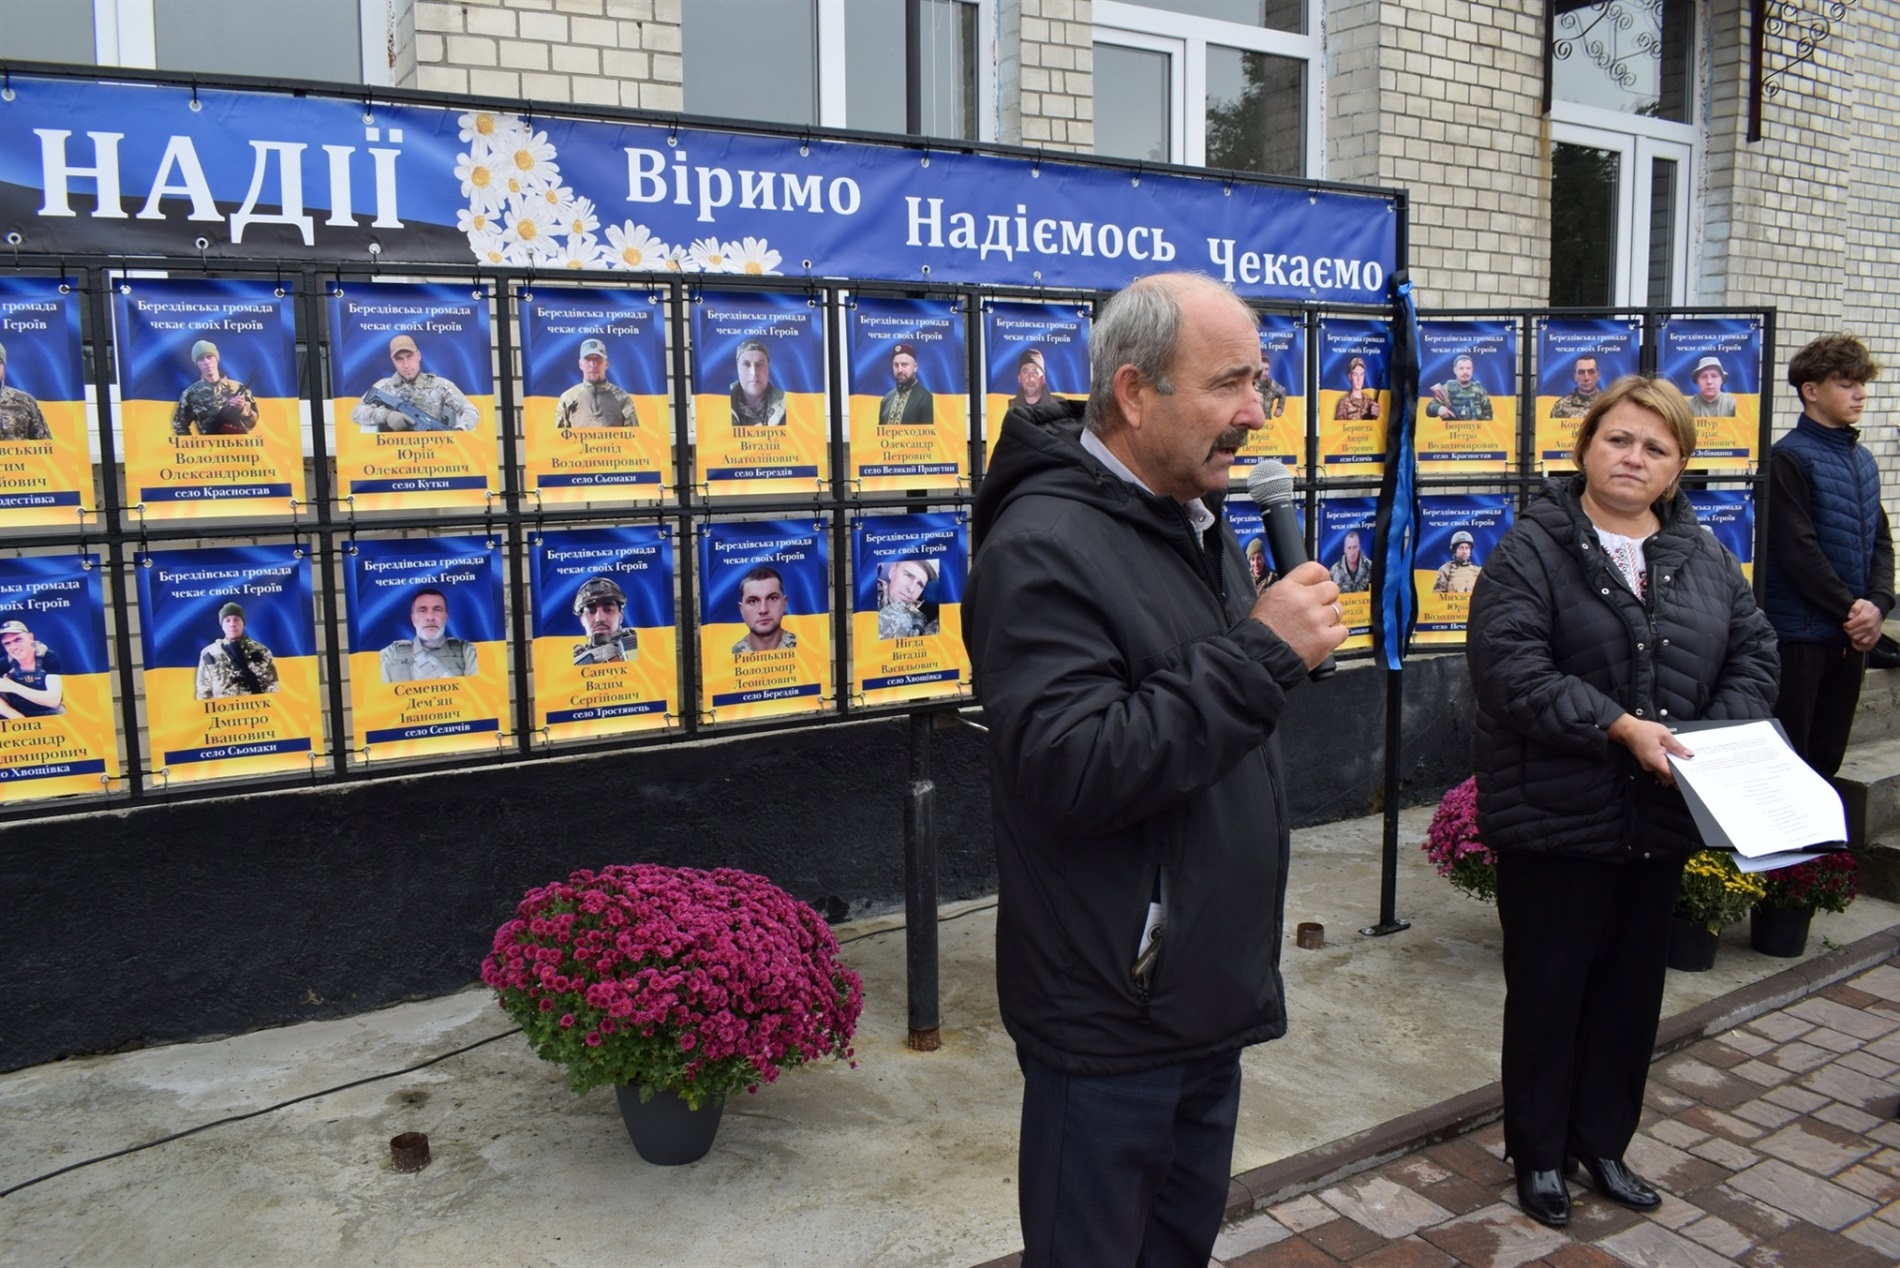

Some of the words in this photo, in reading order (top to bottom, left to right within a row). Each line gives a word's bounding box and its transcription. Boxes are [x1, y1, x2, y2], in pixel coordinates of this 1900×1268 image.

[33, 127, 405, 246] НАДІЇ
[624, 147, 861, 222] Віримо
[905, 197, 1175, 262] Надіємось
[1206, 237, 1383, 292] Чекаємо
[2, 302, 57, 314] громада
[138, 300, 219, 313] Берездівська
[222, 302, 272, 314] громада
[349, 303, 422, 316] Берездівська
[425, 305, 470, 318] громада
[537, 307, 603, 320] Берездівська
[606, 310, 647, 322] громада
[708, 310, 766, 322] Берездівська
[769, 312, 806, 324] громада
[4, 319, 47, 332] Героїв
[150, 321, 184, 329] чекає
[188, 320, 220, 330] своїх
[222, 320, 263, 332] Героїв
[360, 322, 389, 331] чекає
[392, 321, 423, 331] своїх
[426, 322, 462, 333] Героїв
[860, 315, 914, 326] Берездівська
[916, 317, 949, 328] громада
[997, 318, 1044, 331] Берездівська
[1047, 322, 1077, 331] громада
[547, 325, 575, 334] чекає
[578, 325, 604, 334] своїх
[607, 325, 640, 337] Героїв
[716, 327, 741, 336] чекає
[744, 326, 767, 336] своїх
[770, 327, 798, 338] Героїв
[893, 331, 914, 340] своїх
[916, 332, 942, 342] Героїв
[1026, 334, 1044, 342] своїх
[1047, 334, 1070, 344] Героїв
[561, 429, 635, 442] Фурманець
[732, 428, 786, 439] Шклярук
[876, 426, 937, 438] Переходюк
[168, 436, 264, 452] Чайгуцький
[376, 434, 454, 448] Бондарчук
[741, 440, 780, 451] Віталій
[880, 439, 934, 451] Олександр
[398, 448, 435, 461] Юрій
[580, 443, 621, 455] Леонід
[176, 453, 259, 465] Володимир
[722, 453, 799, 465] Анатолійович
[882, 451, 932, 462] Петрович
[551, 457, 650, 470] Володимирович
[864, 466, 881, 474] село
[883, 465, 916, 474] Великий
[918, 464, 954, 474] Правутин
[160, 468, 276, 482] Олександрович
[363, 464, 469, 477] Олександрович
[756, 468, 792, 478] Берездів
[392, 480, 415, 490] село
[418, 479, 449, 490] Кутки
[572, 475, 593, 484] село
[596, 473, 636, 483] Сьомаки
[175, 489, 201, 498] село
[204, 486, 270, 498] Красностав
[866, 532, 919, 544] Берездівська
[921, 531, 954, 541] громада
[715, 540, 773, 551] Берездівська
[776, 538, 812, 549] громада
[898, 546, 919, 555] своїх
[921, 544, 946, 554] Героїв
[547, 548, 613, 561] Берездівська
[615, 546, 656, 558] громада
[723, 557, 748, 565] чекає
[751, 555, 774, 564] своїх
[776, 552, 804, 563] Героїв
[364, 558, 437, 572] Берездівська
[439, 556, 484, 569] громада
[557, 566, 585, 575] чекає
[587, 563, 613, 574] своїх
[616, 562, 648, 573] Героїв
[159, 569, 239, 583] Берездівська
[242, 566, 291, 579] громада
[375, 577, 406, 587] чекає
[409, 574, 438, 585] своїх
[441, 573, 475, 585] Героїв
[27, 582, 79, 594] громада
[171, 589, 206, 598] чекає
[209, 587, 240, 597] своїх
[243, 583, 283, 595] Героїв
[28, 598, 70, 611] Героїв
[734, 650, 795, 664] Рибіцький
[892, 650, 927, 661] Віталій
[581, 666, 628, 680] Санчук
[735, 663, 796, 677] Володимир
[881, 661, 938, 674] Васильович
[733, 676, 797, 689] Леонідович
[905, 673, 942, 684] Хвощівка
[394, 681, 459, 697] Семенюк
[585, 680, 623, 691] Вадим
[570, 691, 639, 707] Сергійович
[743, 693, 761, 701] село
[764, 688, 799, 701] Берездів
[204, 700, 271, 714] Поліщук
[573, 711, 593, 719] село
[596, 704, 649, 718] Тростянець
[208, 716, 269, 731] Дмитро
[400, 710, 460, 725] Іванович
[2, 721, 41, 732] Гона
[405, 729, 427, 737] село
[430, 723, 471, 735] Селичів
[0, 735, 65, 748] лександр
[204, 730, 275, 745] Іванович
[0, 748, 87, 765] димирович
[200, 749, 226, 758] село
[228, 743, 277, 756] Сьомаки
[11, 765, 70, 778] Хвощівка
